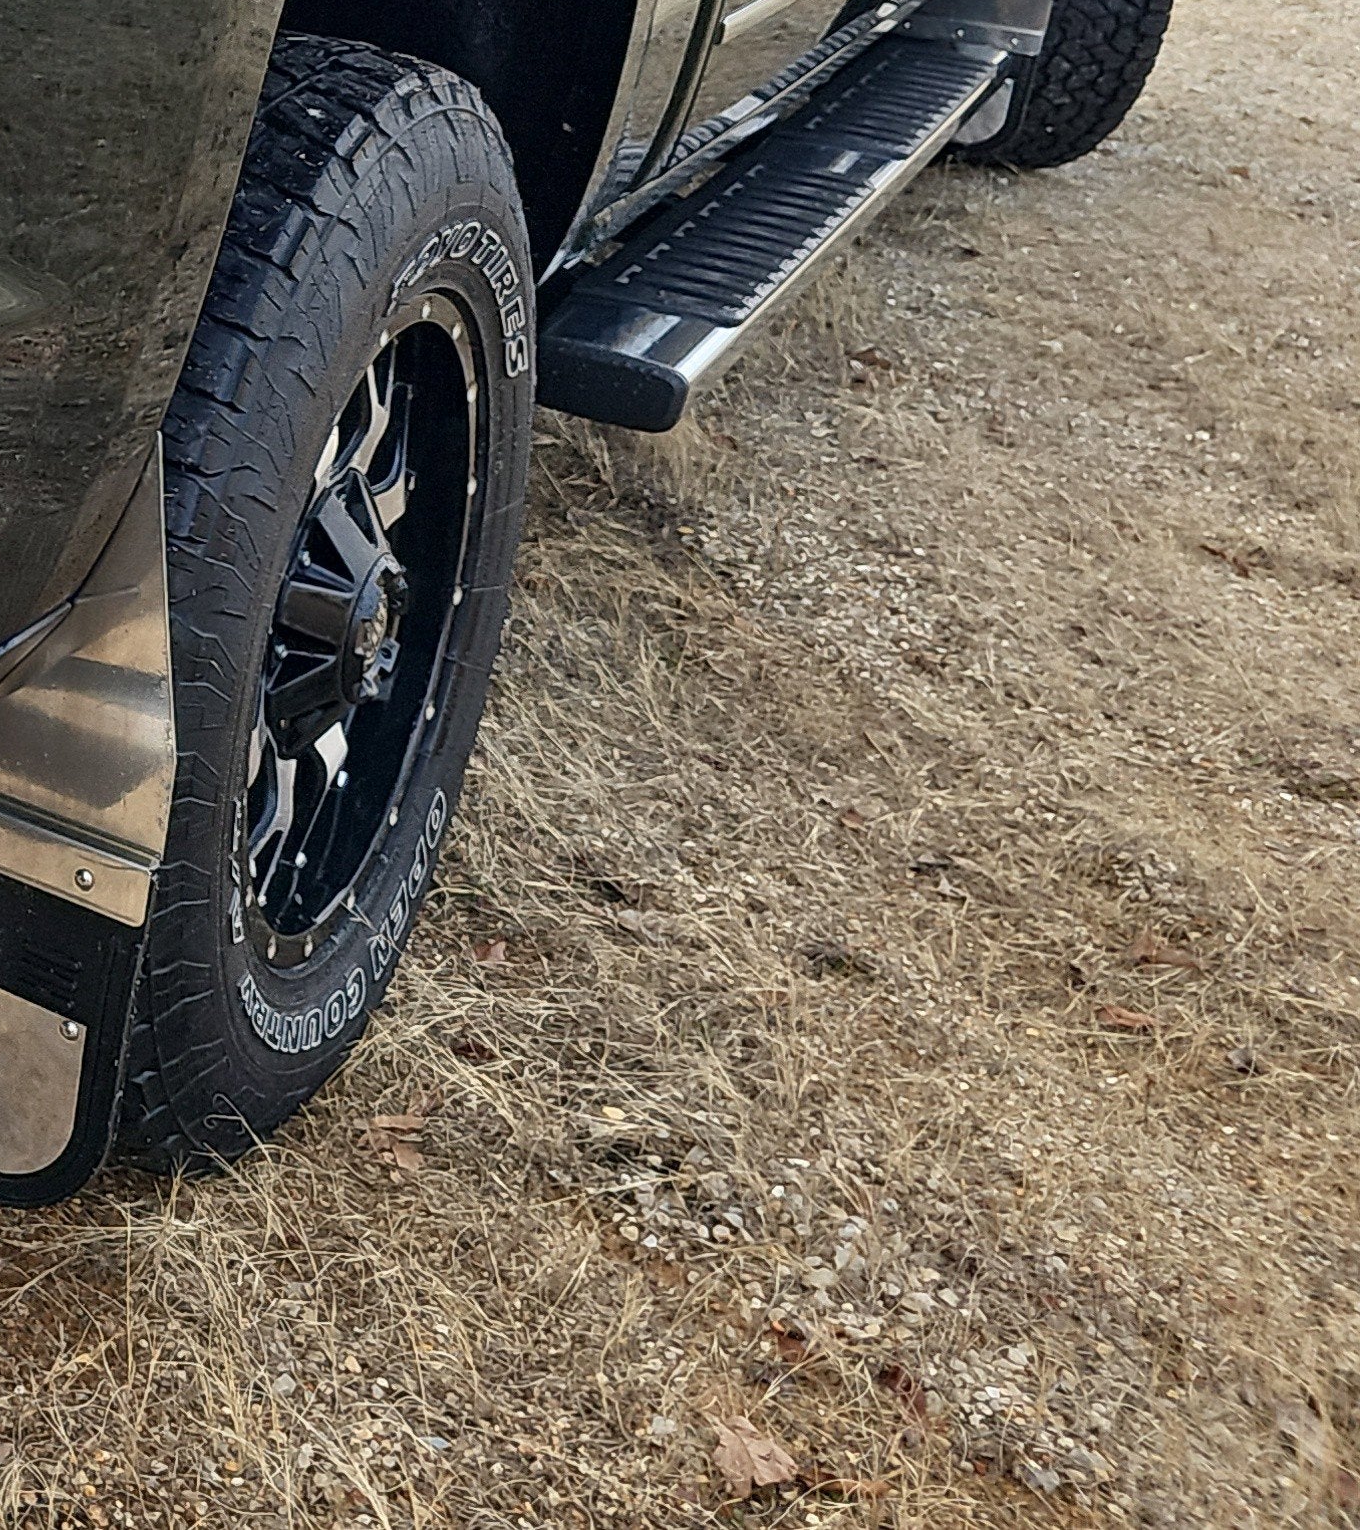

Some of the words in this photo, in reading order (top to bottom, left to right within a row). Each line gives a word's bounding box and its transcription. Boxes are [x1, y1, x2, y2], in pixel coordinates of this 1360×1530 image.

[470, 228, 530, 378] TIRES
[368, 788, 448, 981] OPEN
[239, 967, 367, 1054] COUNTRY
